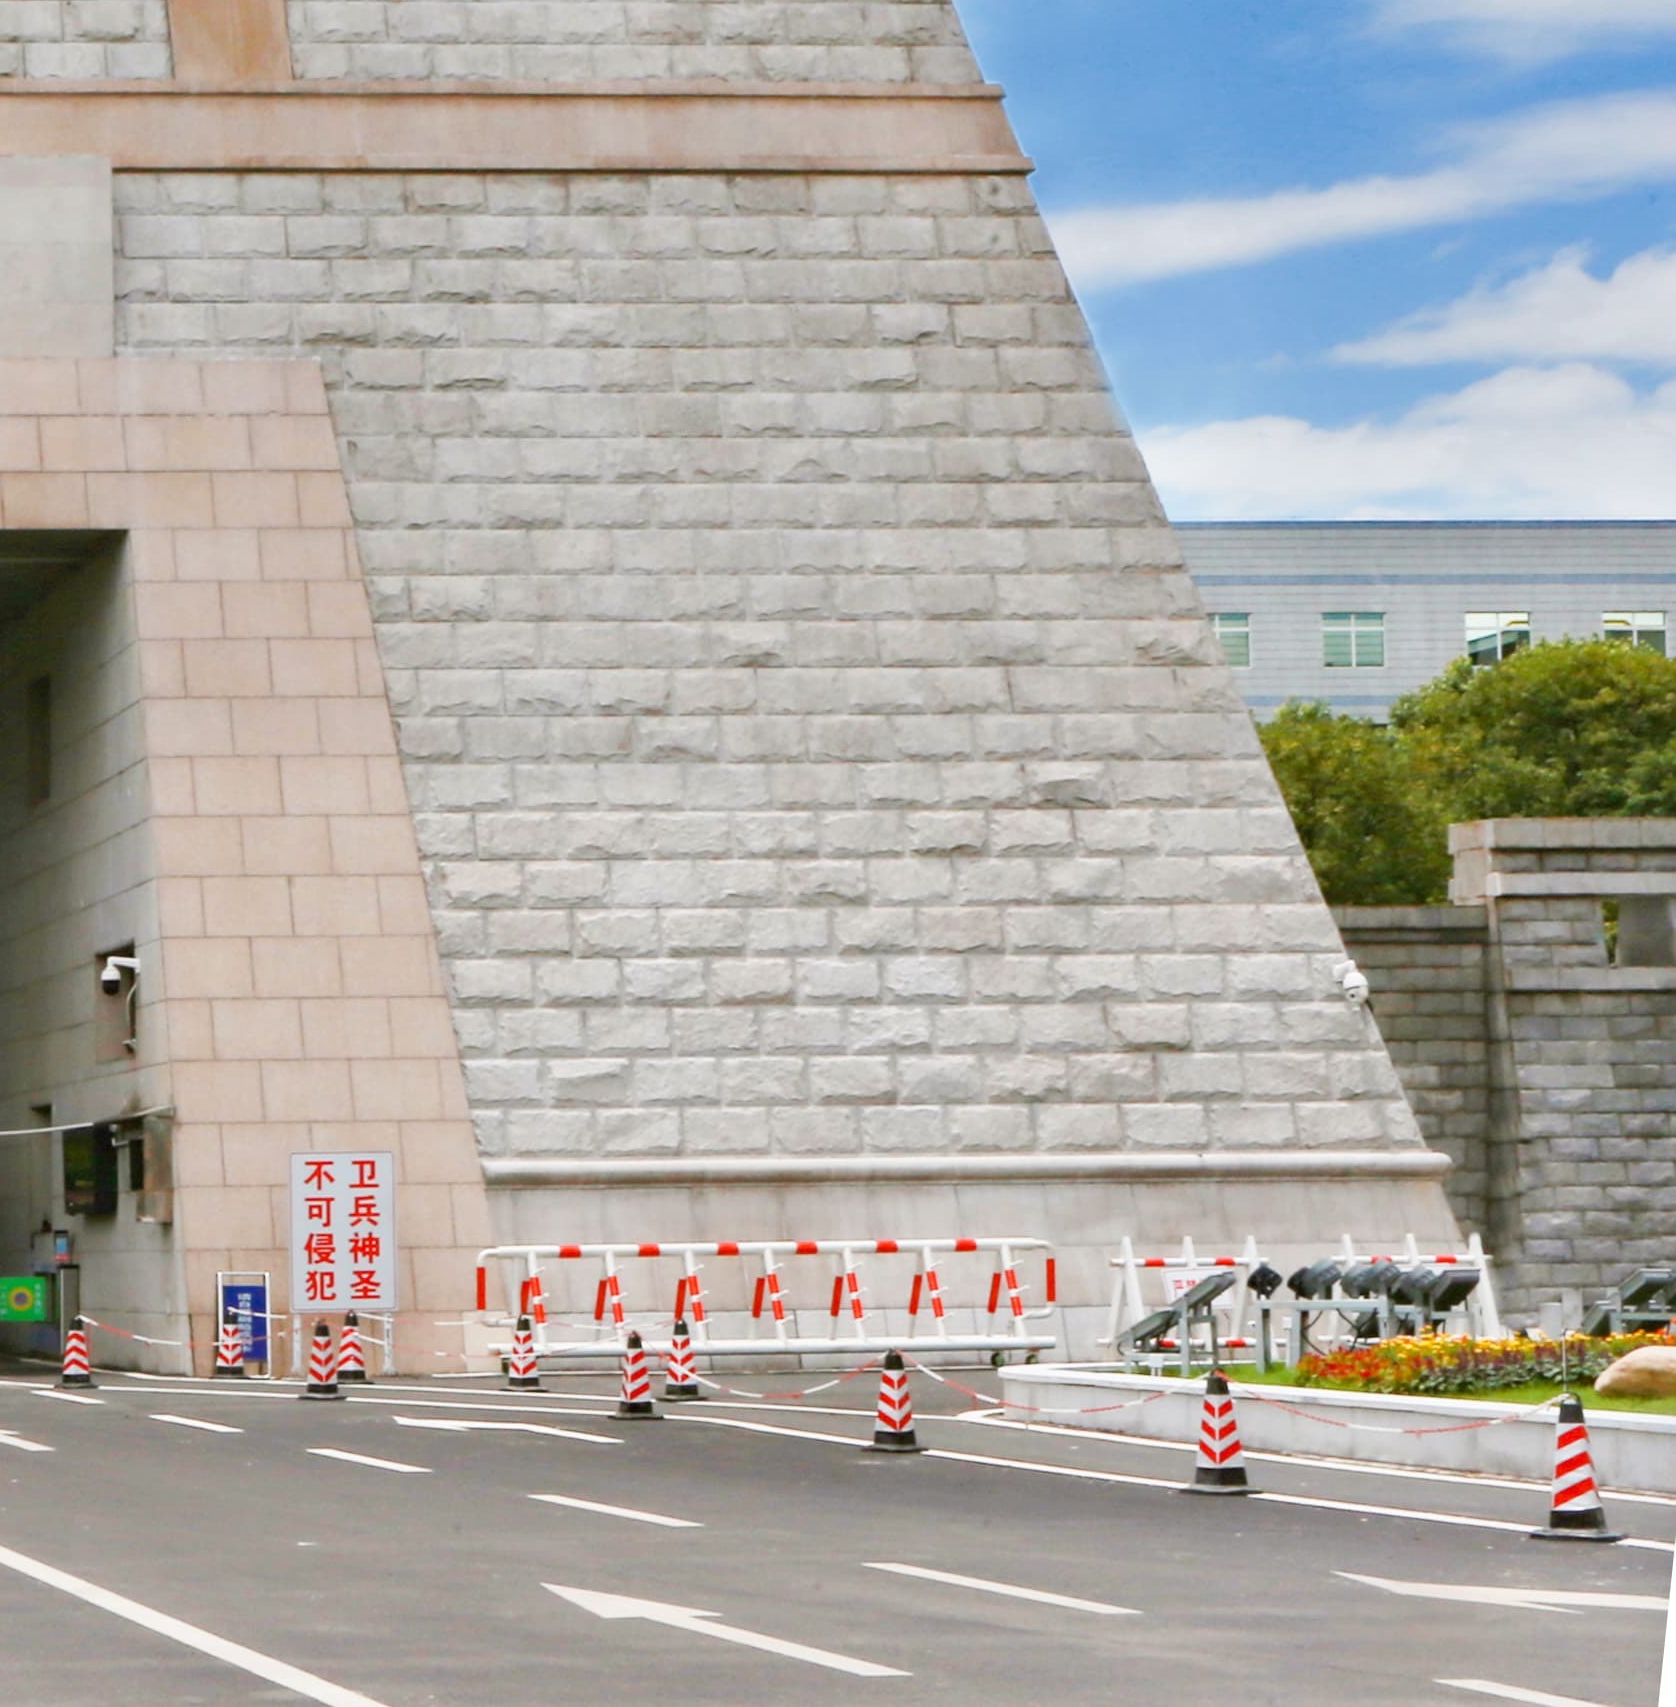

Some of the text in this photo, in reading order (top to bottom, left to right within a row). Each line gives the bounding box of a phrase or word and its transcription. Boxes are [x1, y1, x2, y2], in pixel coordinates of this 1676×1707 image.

[303, 1160, 337, 1302] 不可侵犯
[348, 1159, 381, 1300] 卫兵神圣
